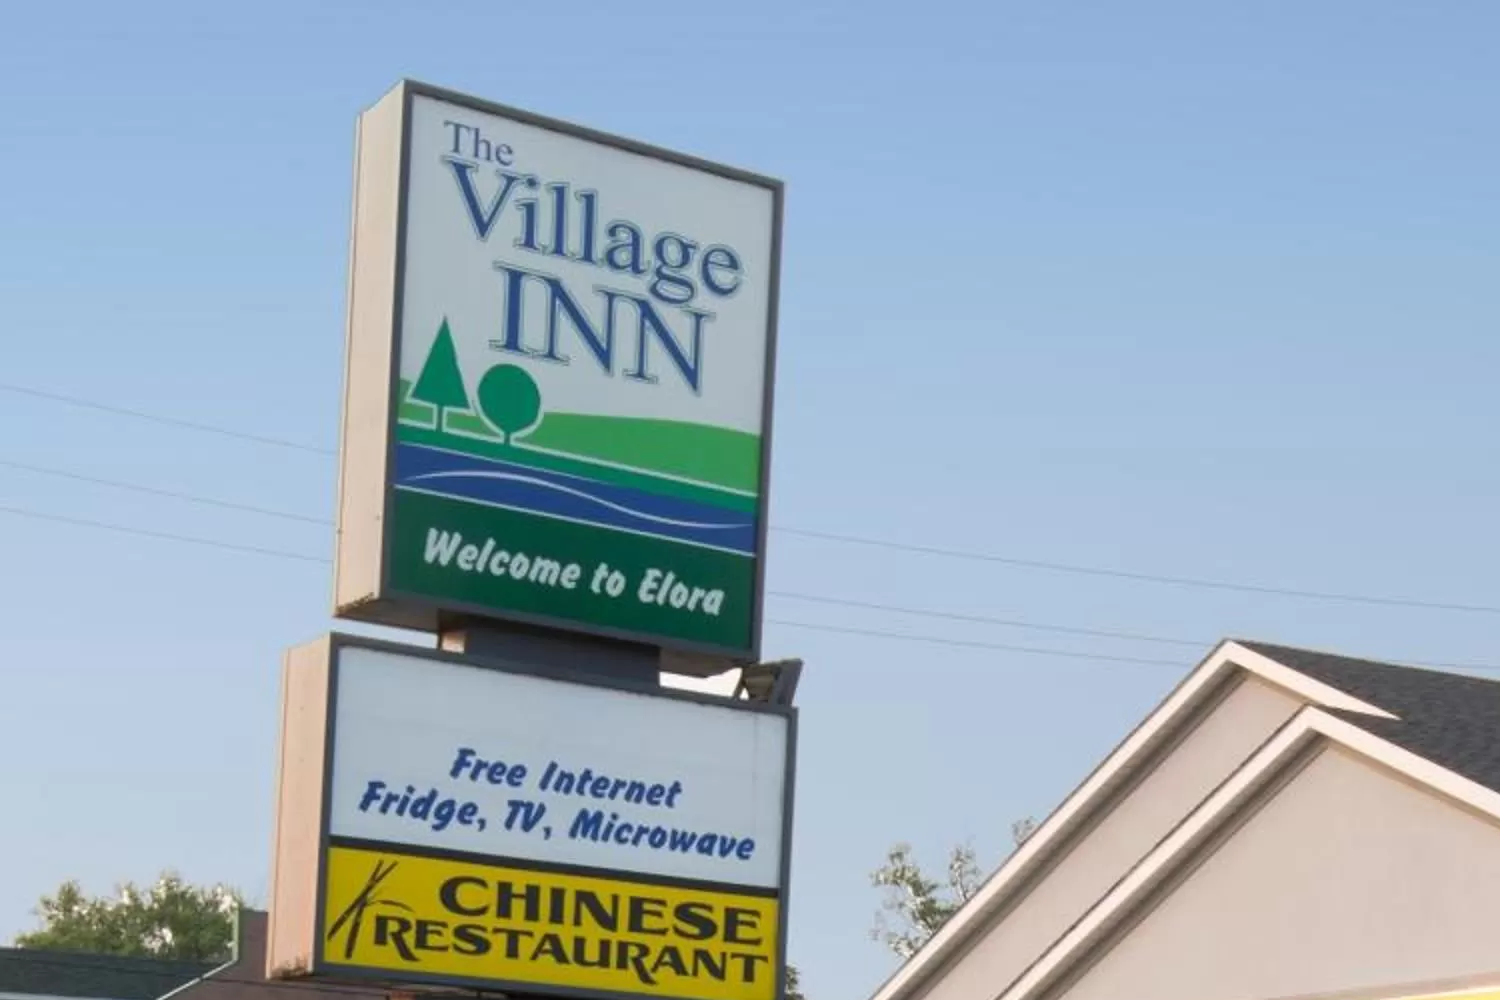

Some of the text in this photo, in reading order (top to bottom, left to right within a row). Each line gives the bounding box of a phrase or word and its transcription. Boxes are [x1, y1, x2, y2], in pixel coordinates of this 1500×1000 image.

[443, 119, 515, 167] The
[441, 154, 744, 306] Village
[488, 260, 717, 398] INN
[423, 527, 727, 616] Welcome to Elora
[449, 747, 682, 808] Free Internet
[358, 781, 757, 861] Fridge, TV, Microwave
[373, 912, 769, 985] RESTAURANT
[439, 876, 764, 946] CHINESE
